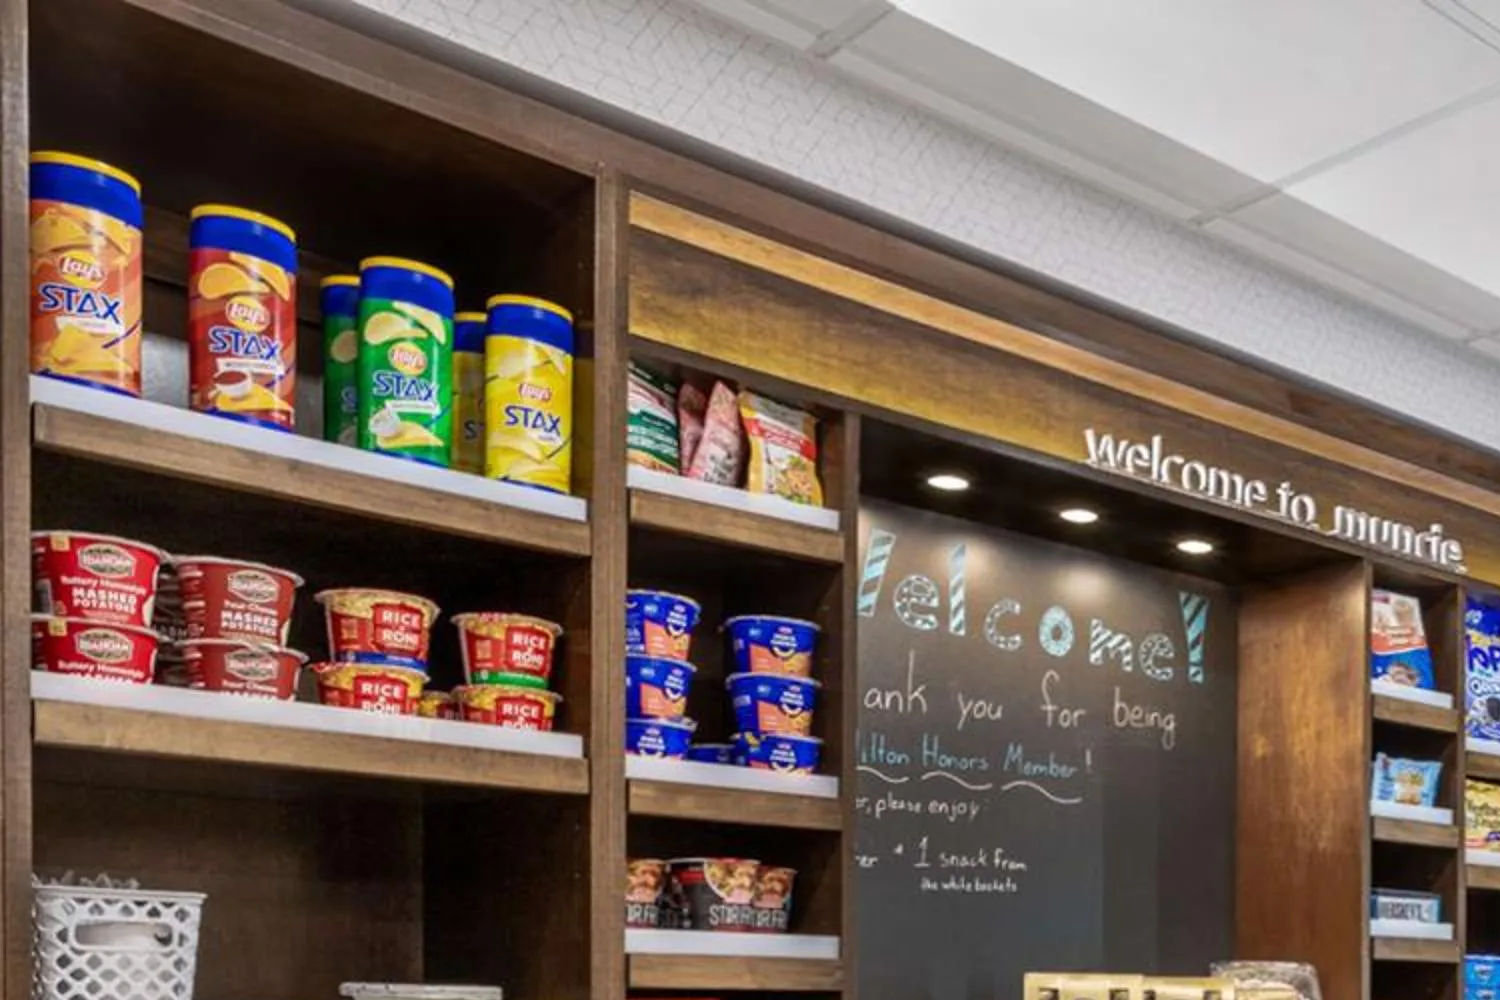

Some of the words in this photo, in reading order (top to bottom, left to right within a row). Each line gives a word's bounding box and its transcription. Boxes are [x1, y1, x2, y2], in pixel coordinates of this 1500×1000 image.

[40, 283, 121, 324] STAX
[208, 326, 280, 360] STAX
[372, 369, 438, 401] STAX
[505, 404, 562, 437] STAX
[1084, 428, 1267, 508] welcome
[1276, 480, 1318, 526] to
[72, 586, 137, 605] MASHED
[381, 608, 421, 627] RICE
[382, 630, 420, 647] RONI
[512, 631, 546, 649] RICE
[511, 648, 545, 666] RONI
[361, 683, 401, 698] RICE
[863, 650, 928, 714] ank
[957, 693, 1003, 731] you
[1040, 669, 1087, 728] for
[1113, 686, 1178, 750] being
[502, 702, 540, 718] RICE
[921, 733, 989, 770] Honors
[875, 790, 921, 819] please
[928, 799, 980, 823] enjoy
[938, 848, 987, 868] snack
